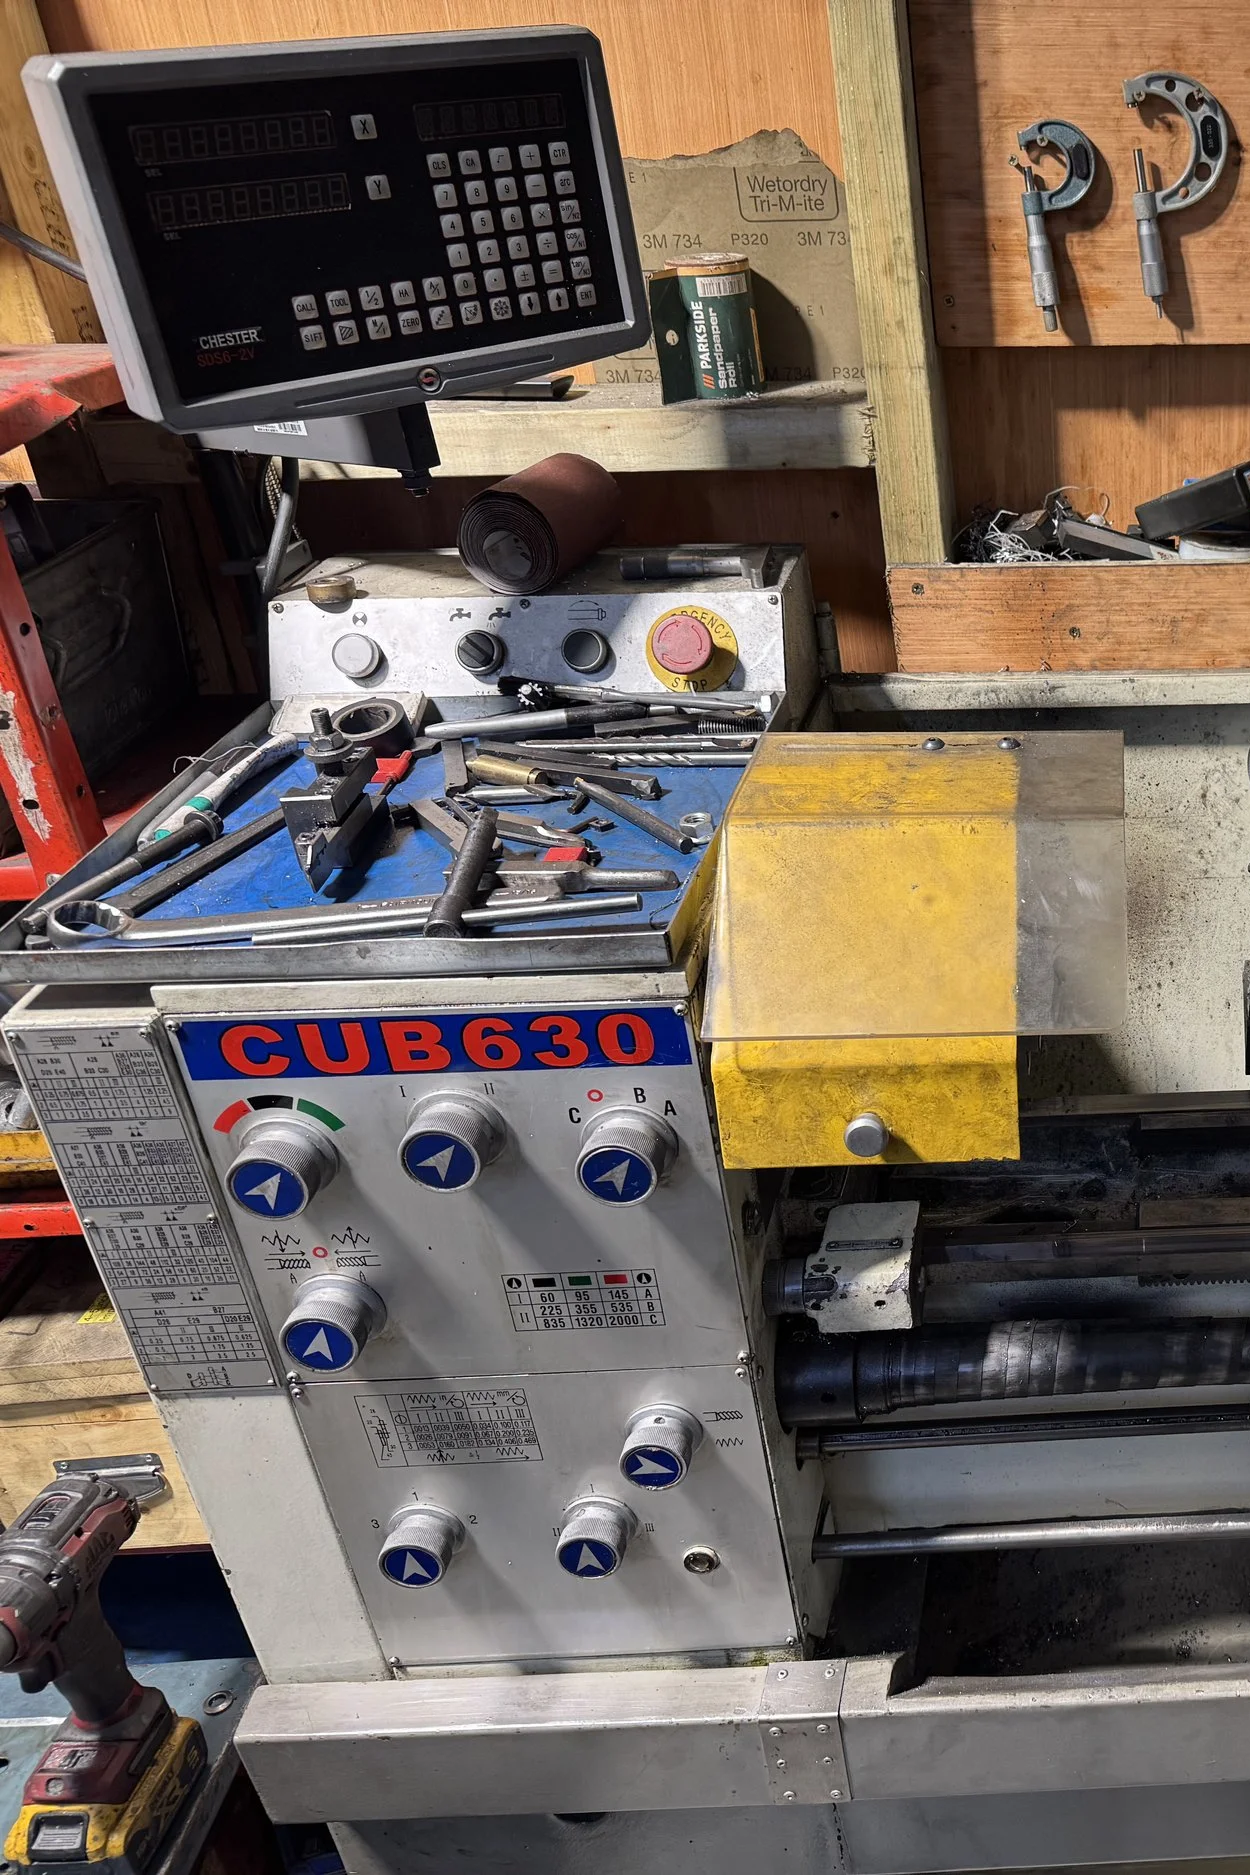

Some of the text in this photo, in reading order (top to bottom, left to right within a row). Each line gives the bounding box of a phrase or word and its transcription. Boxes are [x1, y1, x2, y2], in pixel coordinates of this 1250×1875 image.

[359, 119, 369, 135] X
[553, 148, 567, 158] CTR
[432, 160, 447, 170] CLS
[559, 177, 571, 187] arc
[747, 175, 827, 196] Wetordry
[374, 180, 382, 195] Y
[474, 188, 480, 197] 8
[504, 184, 510, 194] 9
[443, 191, 448, 201] 7
[749, 194, 825, 212] Tri-M-ite
[481, 218, 486, 227] 5
[510, 214, 516, 223] 6
[450, 221, 456, 231] 4
[642, 231, 851, 249] 3M 734 P320 3M 73
[487, 247, 492, 256] 2
[516, 243, 522, 252] 3
[458, 251, 462, 260] 1
[463, 280, 469, 289] 0
[399, 289, 409, 298] HA
[581, 290, 593, 299] ENT
[296, 303, 315, 312] CALL
[330, 299, 349, 308] TOOL
[401, 318, 420, 327] ZERO
[200, 329, 260, 349] CHESTER
[304, 333, 323, 343] SIFT
[691, 301, 712, 369] PARKSIDE
[708, 307, 727, 389] Sandpaper
[197, 347, 256, 367] SDS6-2V
[606, 369, 630, 383] 3M
[726, 362, 737, 388] Roll
[672, 677, 707, 691] STOP
[219, 1013, 655, 1077] CUB630
[634, 1088, 647, 1103] B
[663, 1100, 677, 1116] A
[569, 1107, 582, 1125] C
[540, 1292, 555, 1303] 60
[575, 1291, 590, 1302] 95
[608, 1290, 629, 1300] 145
[644, 1288, 652, 1298] A
[540, 1301, 655, 1316] 225 355 535 B
[543, 1318, 566, 1328] 835
[575, 1316, 603, 1327] 1320
[609, 1315, 639, 1325] 2000
[649, 1314, 657, 1325] C
[412, 1491, 419, 1501] 1
[370, 1518, 380, 1529] 3
[469, 1515, 478, 1525] 2
